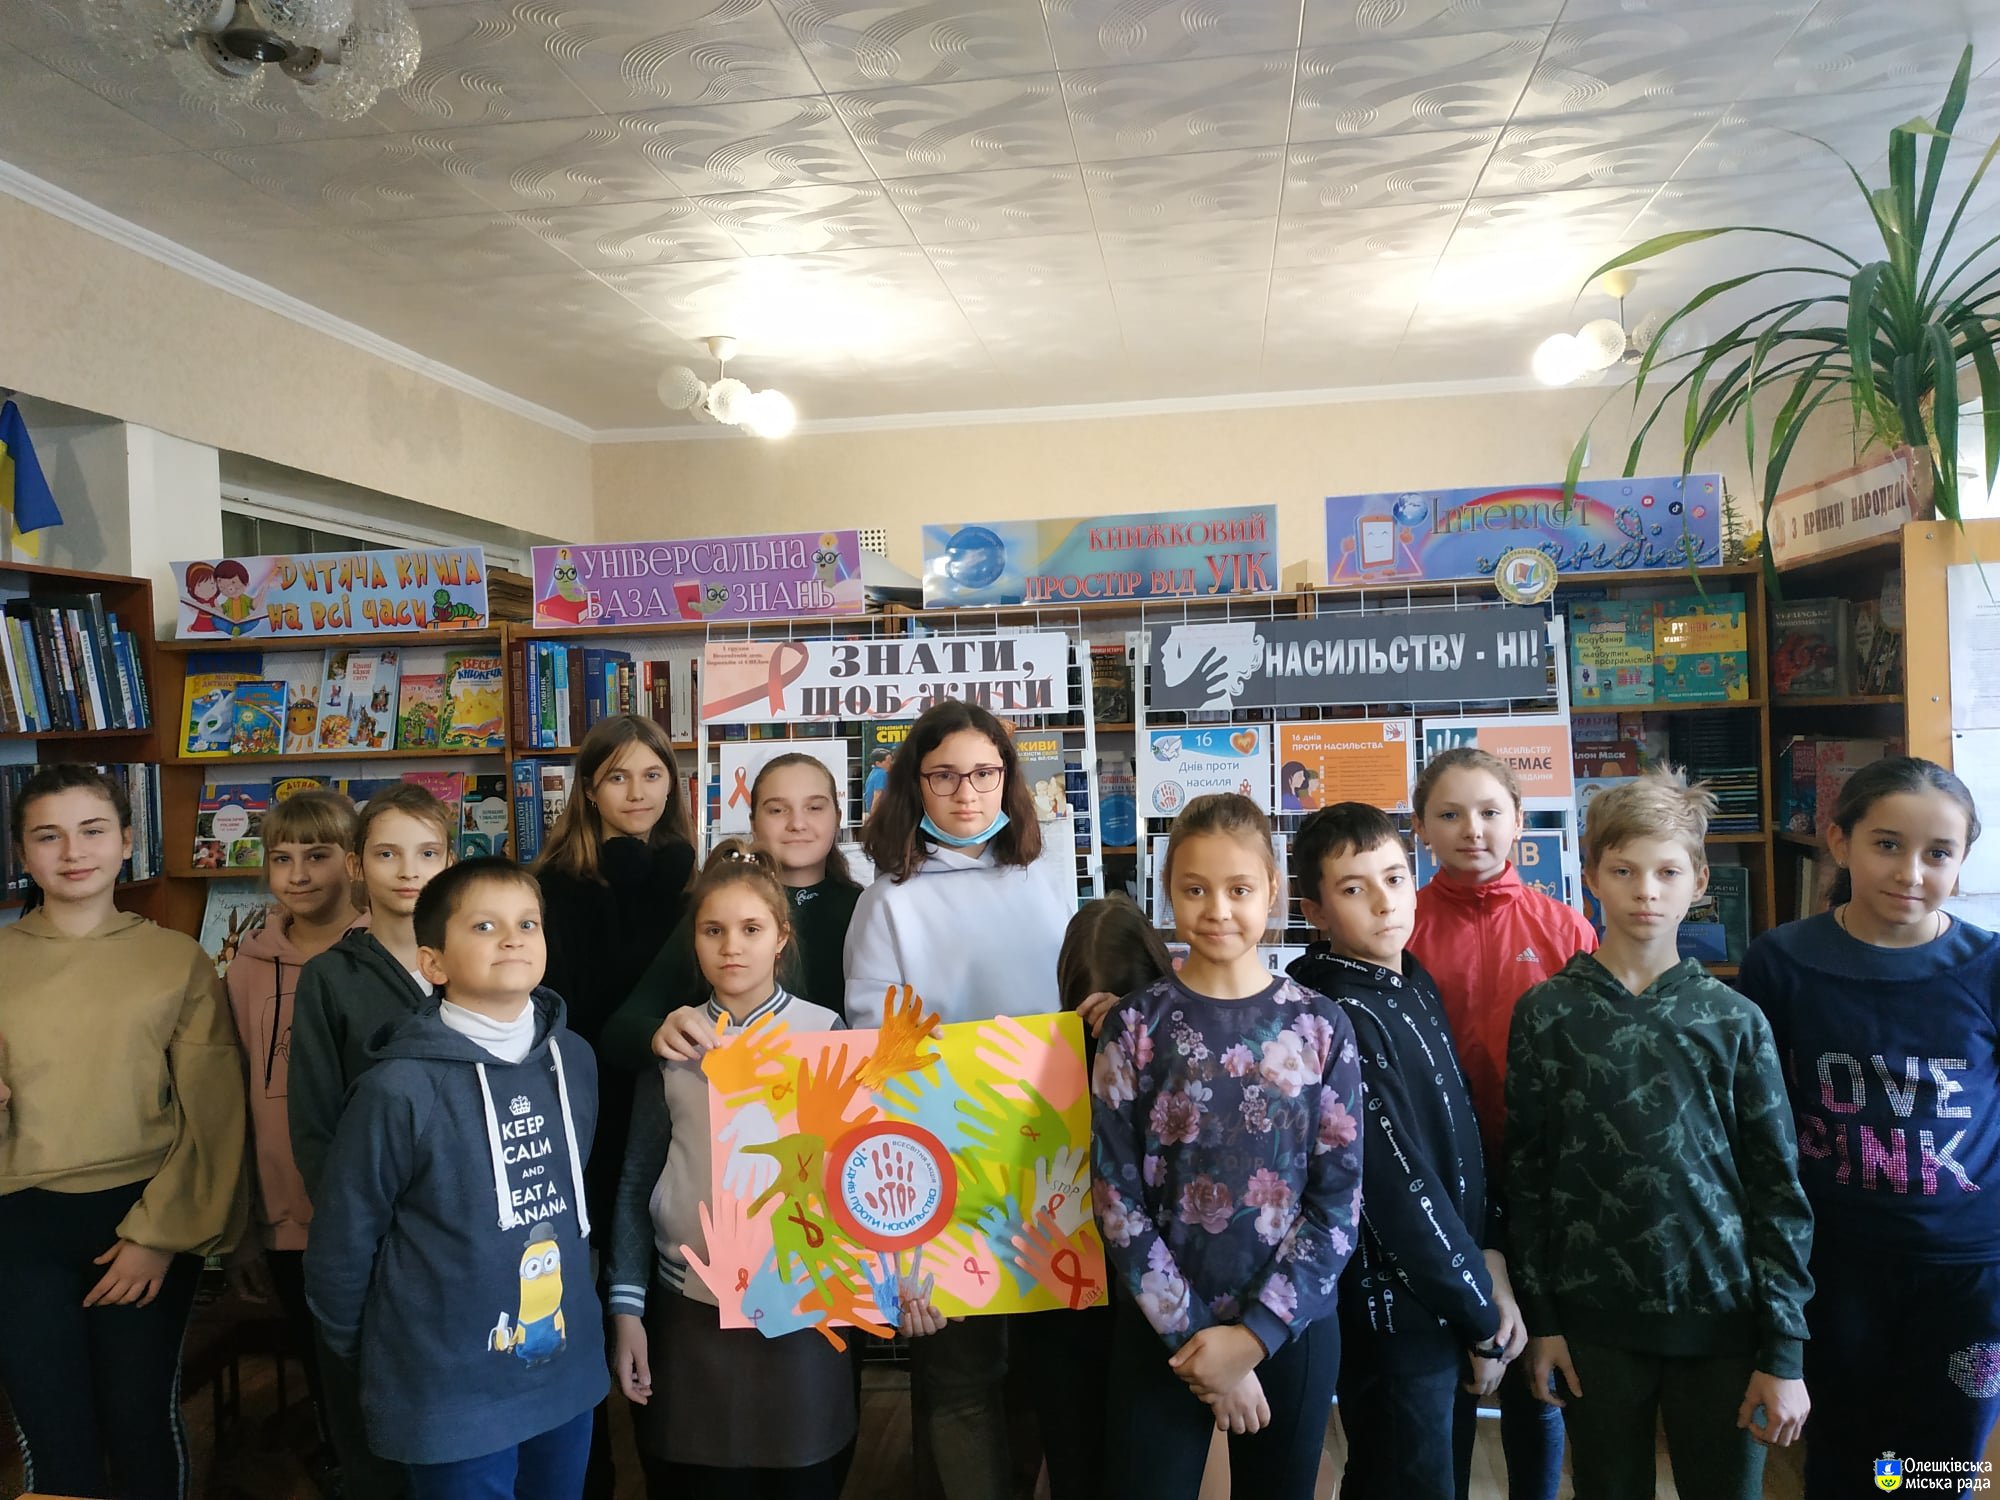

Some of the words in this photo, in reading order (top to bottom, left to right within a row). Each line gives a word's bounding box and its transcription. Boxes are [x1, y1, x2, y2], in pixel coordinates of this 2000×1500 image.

[1791, 516, 1798, 540] З
[1803, 501, 1845, 536] КРИНИЦІ
[1850, 474, 1908, 523] НАРОДНОЇ
[1088, 511, 1267, 552] КНИЖКОВИЙ
[279, 553, 387, 595] ДИТЯЧА
[1023, 570, 1142, 601] ПРОСТІР
[1150, 567, 1197, 598] ВІД
[1207, 551, 1273, 595] УІК
[266, 602, 303, 633] на
[310, 593, 352, 631] всі
[361, 597, 429, 629] часи
[584, 588, 668, 620] БАЗА
[732, 579, 834, 613] ЗНАНЬ
[829, 638, 1035, 681] ЗНАТИ,
[1264, 631, 1467, 679] НАСИЛЬСТВУ
[1496, 628, 1540, 669] НІ!
[456, 668, 503, 681] КНИЖЕЧК
[799, 683, 901, 718] ЩОБ
[918, 677, 1055, 714] ЖИТИ
[1195, 731, 1213, 747] 16
[1291, 733, 1301, 742] 16
[1302, 732, 1322, 742] днів
[1291, 742, 1322, 752] ПРОТИ
[1323, 741, 1384, 751] НАСИЛЬСТВА
[1178, 761, 1203, 773] Днів
[1206, 761, 1240, 773] проти
[1186, 778, 1232, 788] насилля
[1315, 953, 1369, 973] Champion
[1816, 1052, 1972, 1118] OVE
[501, 1114, 546, 1141] KEEP
[1379, 1115, 1412, 1175] Champion
[503, 1136, 553, 1165] CALM
[852, 1150, 869, 1169] 16
[892, 1139, 929, 1163] ВСЕСВІТНЯ
[925, 1162, 938, 1184] АКЦІЯ
[521, 1164, 545, 1180] AND
[1049, 1179, 1081, 1199] STOP
[511, 1184, 544, 1207] EAT
[546, 1180, 557, 1198] A
[877, 1181, 917, 1219] STOP
[502, 1196, 568, 1231] ANANA
[1420, 1195, 1452, 1252] Champion
[1461, 1269, 1489, 1307] Champ
